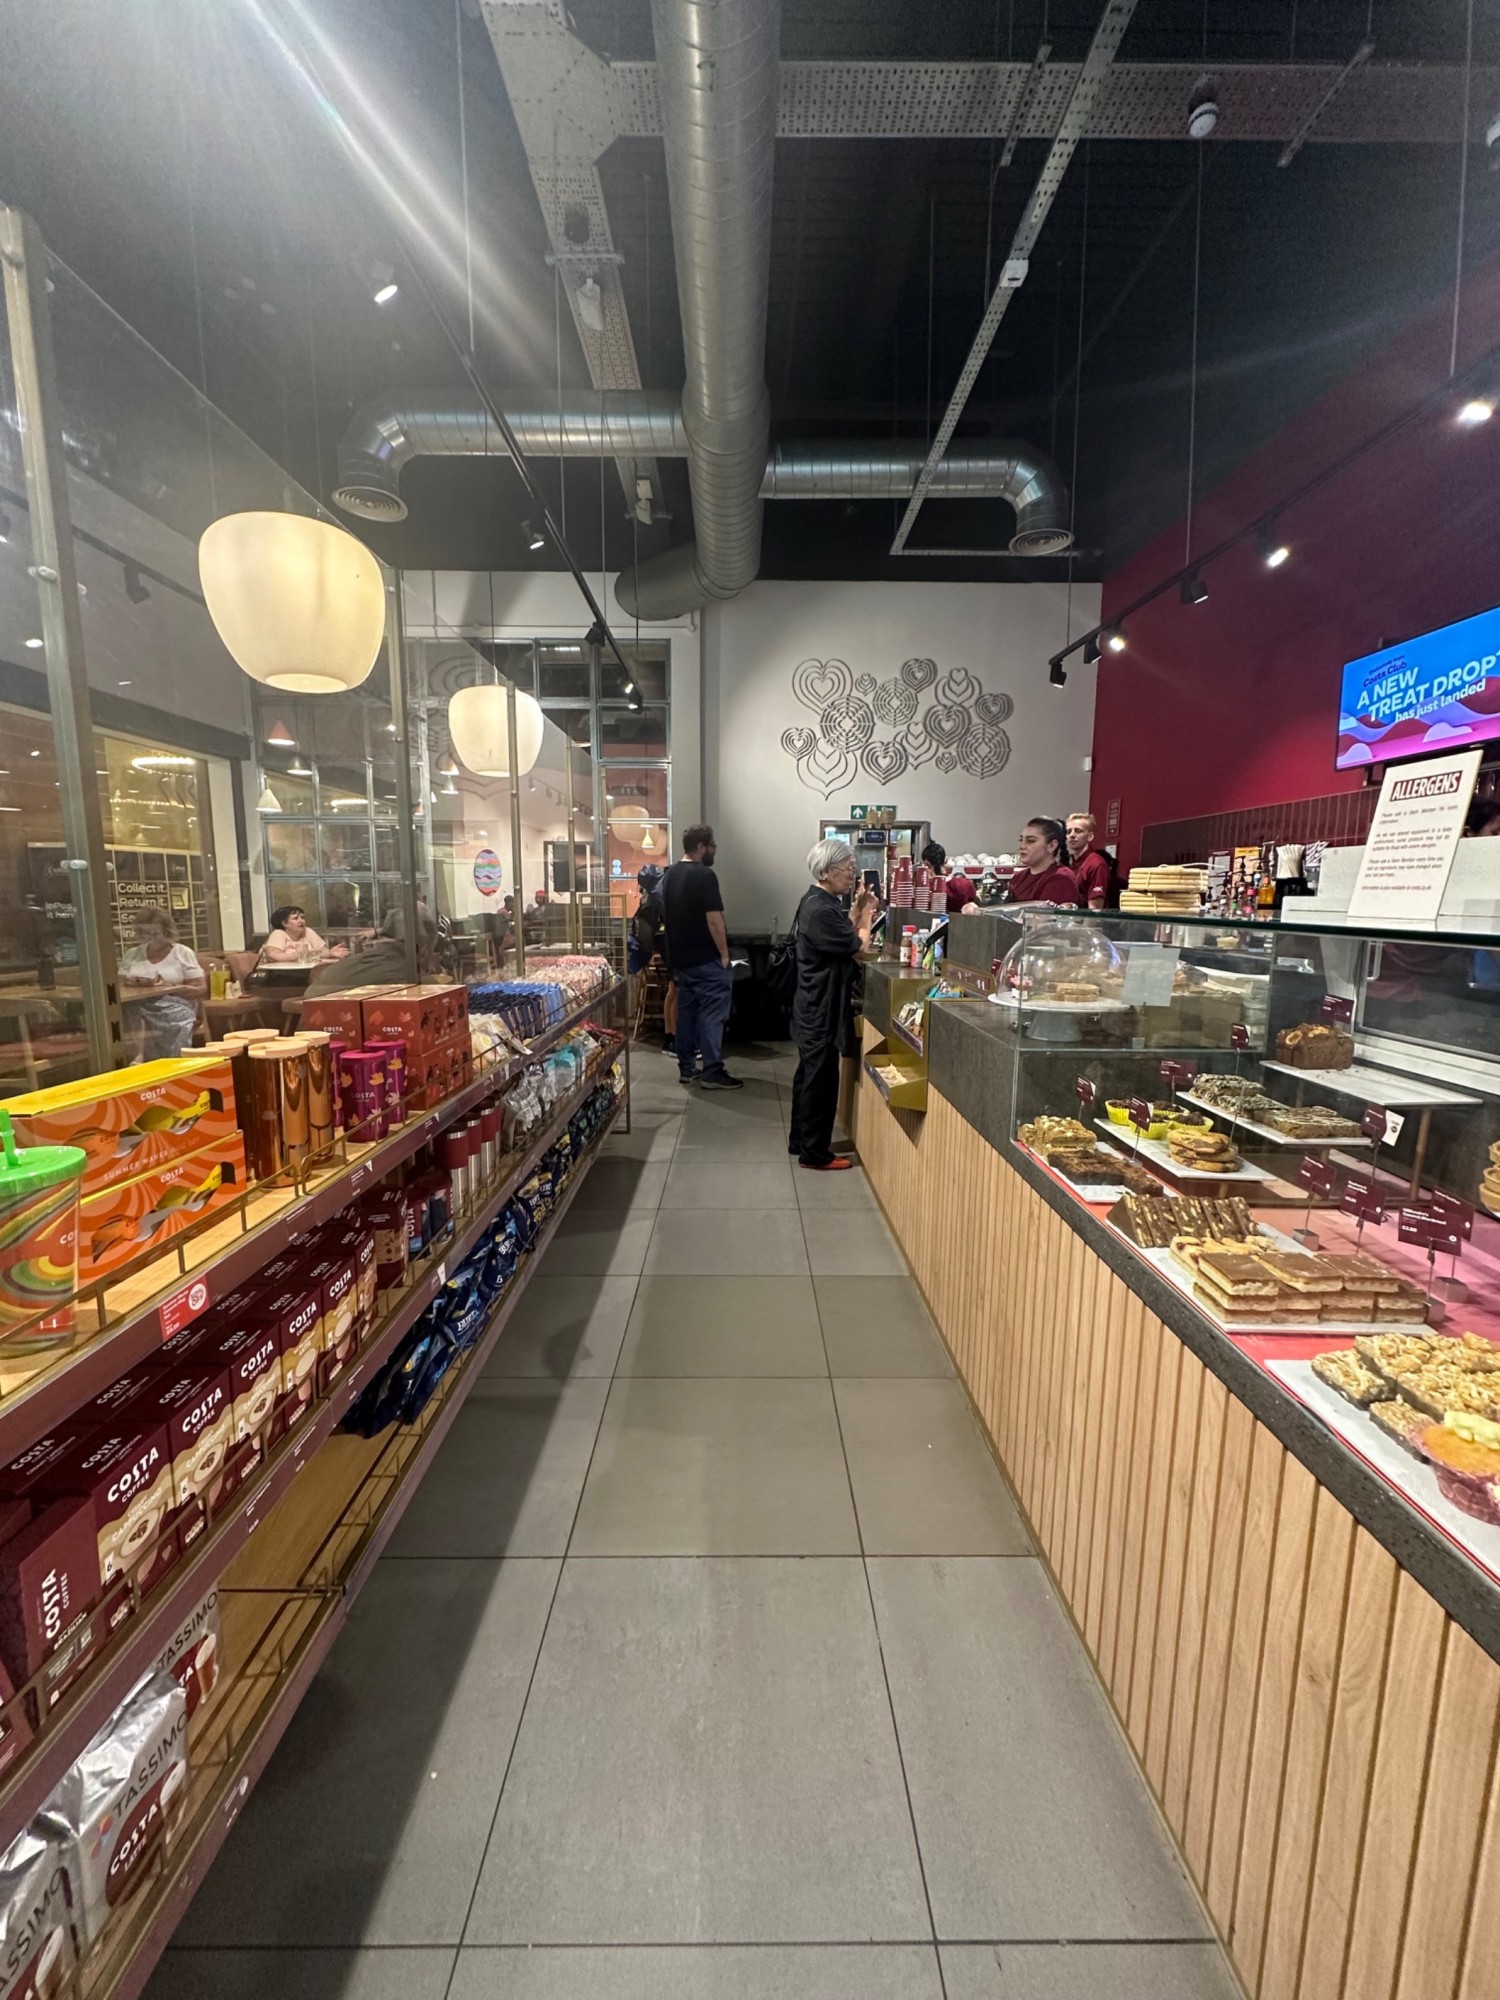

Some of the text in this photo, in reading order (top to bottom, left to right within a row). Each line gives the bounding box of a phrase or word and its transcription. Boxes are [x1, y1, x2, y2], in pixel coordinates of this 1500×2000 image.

[1357, 667, 1419, 710] A NEW
[1363, 661, 1407, 688] Costa Club
[1368, 650, 1500, 722] TREAT DROP
[1395, 678, 1486, 723] has just landed
[1391, 772, 1460, 800] ALLERGENS
[118, 882, 169, 893] Collect it.
[119, 897, 157, 907] Return
[45, 902, 73, 911] InPos
[140, 1087, 166, 1101] COSTA
[103, 1160, 140, 1182] SUMMER
[142, 1149, 169, 1165] WAVES
[160, 1167, 184, 1183] COSTA
[407, 1208, 416, 1237] COSTA
[360, 1239, 375, 1262] COSTA
[310, 1261, 330, 1277] COSTA
[329, 1269, 352, 1297] COSTA
[269, 1293, 293, 1311] COSTA
[289, 1301, 317, 1334] COSTA
[162, 1330, 191, 1351] COSTA
[219, 1330, 247, 1351] COSTA
[240, 1340, 274, 1378] COSTA
[249, 1359, 268, 1380] COFFEE
[96, 1379, 131, 1404] COSTA
[159, 1379, 192, 1404] COSTA
[182, 1387, 223, 1433] COSTA
[192, 1409, 215, 1434] COFFEE
[11, 1439, 55, 1470] COSTA
[81, 1437, 122, 1468] COSTA
[185, 1424, 226, 1469] CAPPUCCINO
[107, 1447, 159, 1502] COSTA
[121, 1471, 150, 1503] COFFEE
[111, 1487, 162, 1543] CAPPUCCINO
[41, 1568, 61, 1639] COSTA
[60, 1572, 70, 1609] COFFEE
[54, 1611, 87, 1650] BRAZILIAN
[157, 1591, 218, 1670] TASSIMO
[113, 1710, 188, 1818] TASSIMO
[110, 1803, 158, 1876] COSTA
[124, 1835, 148, 1873] LATTE
